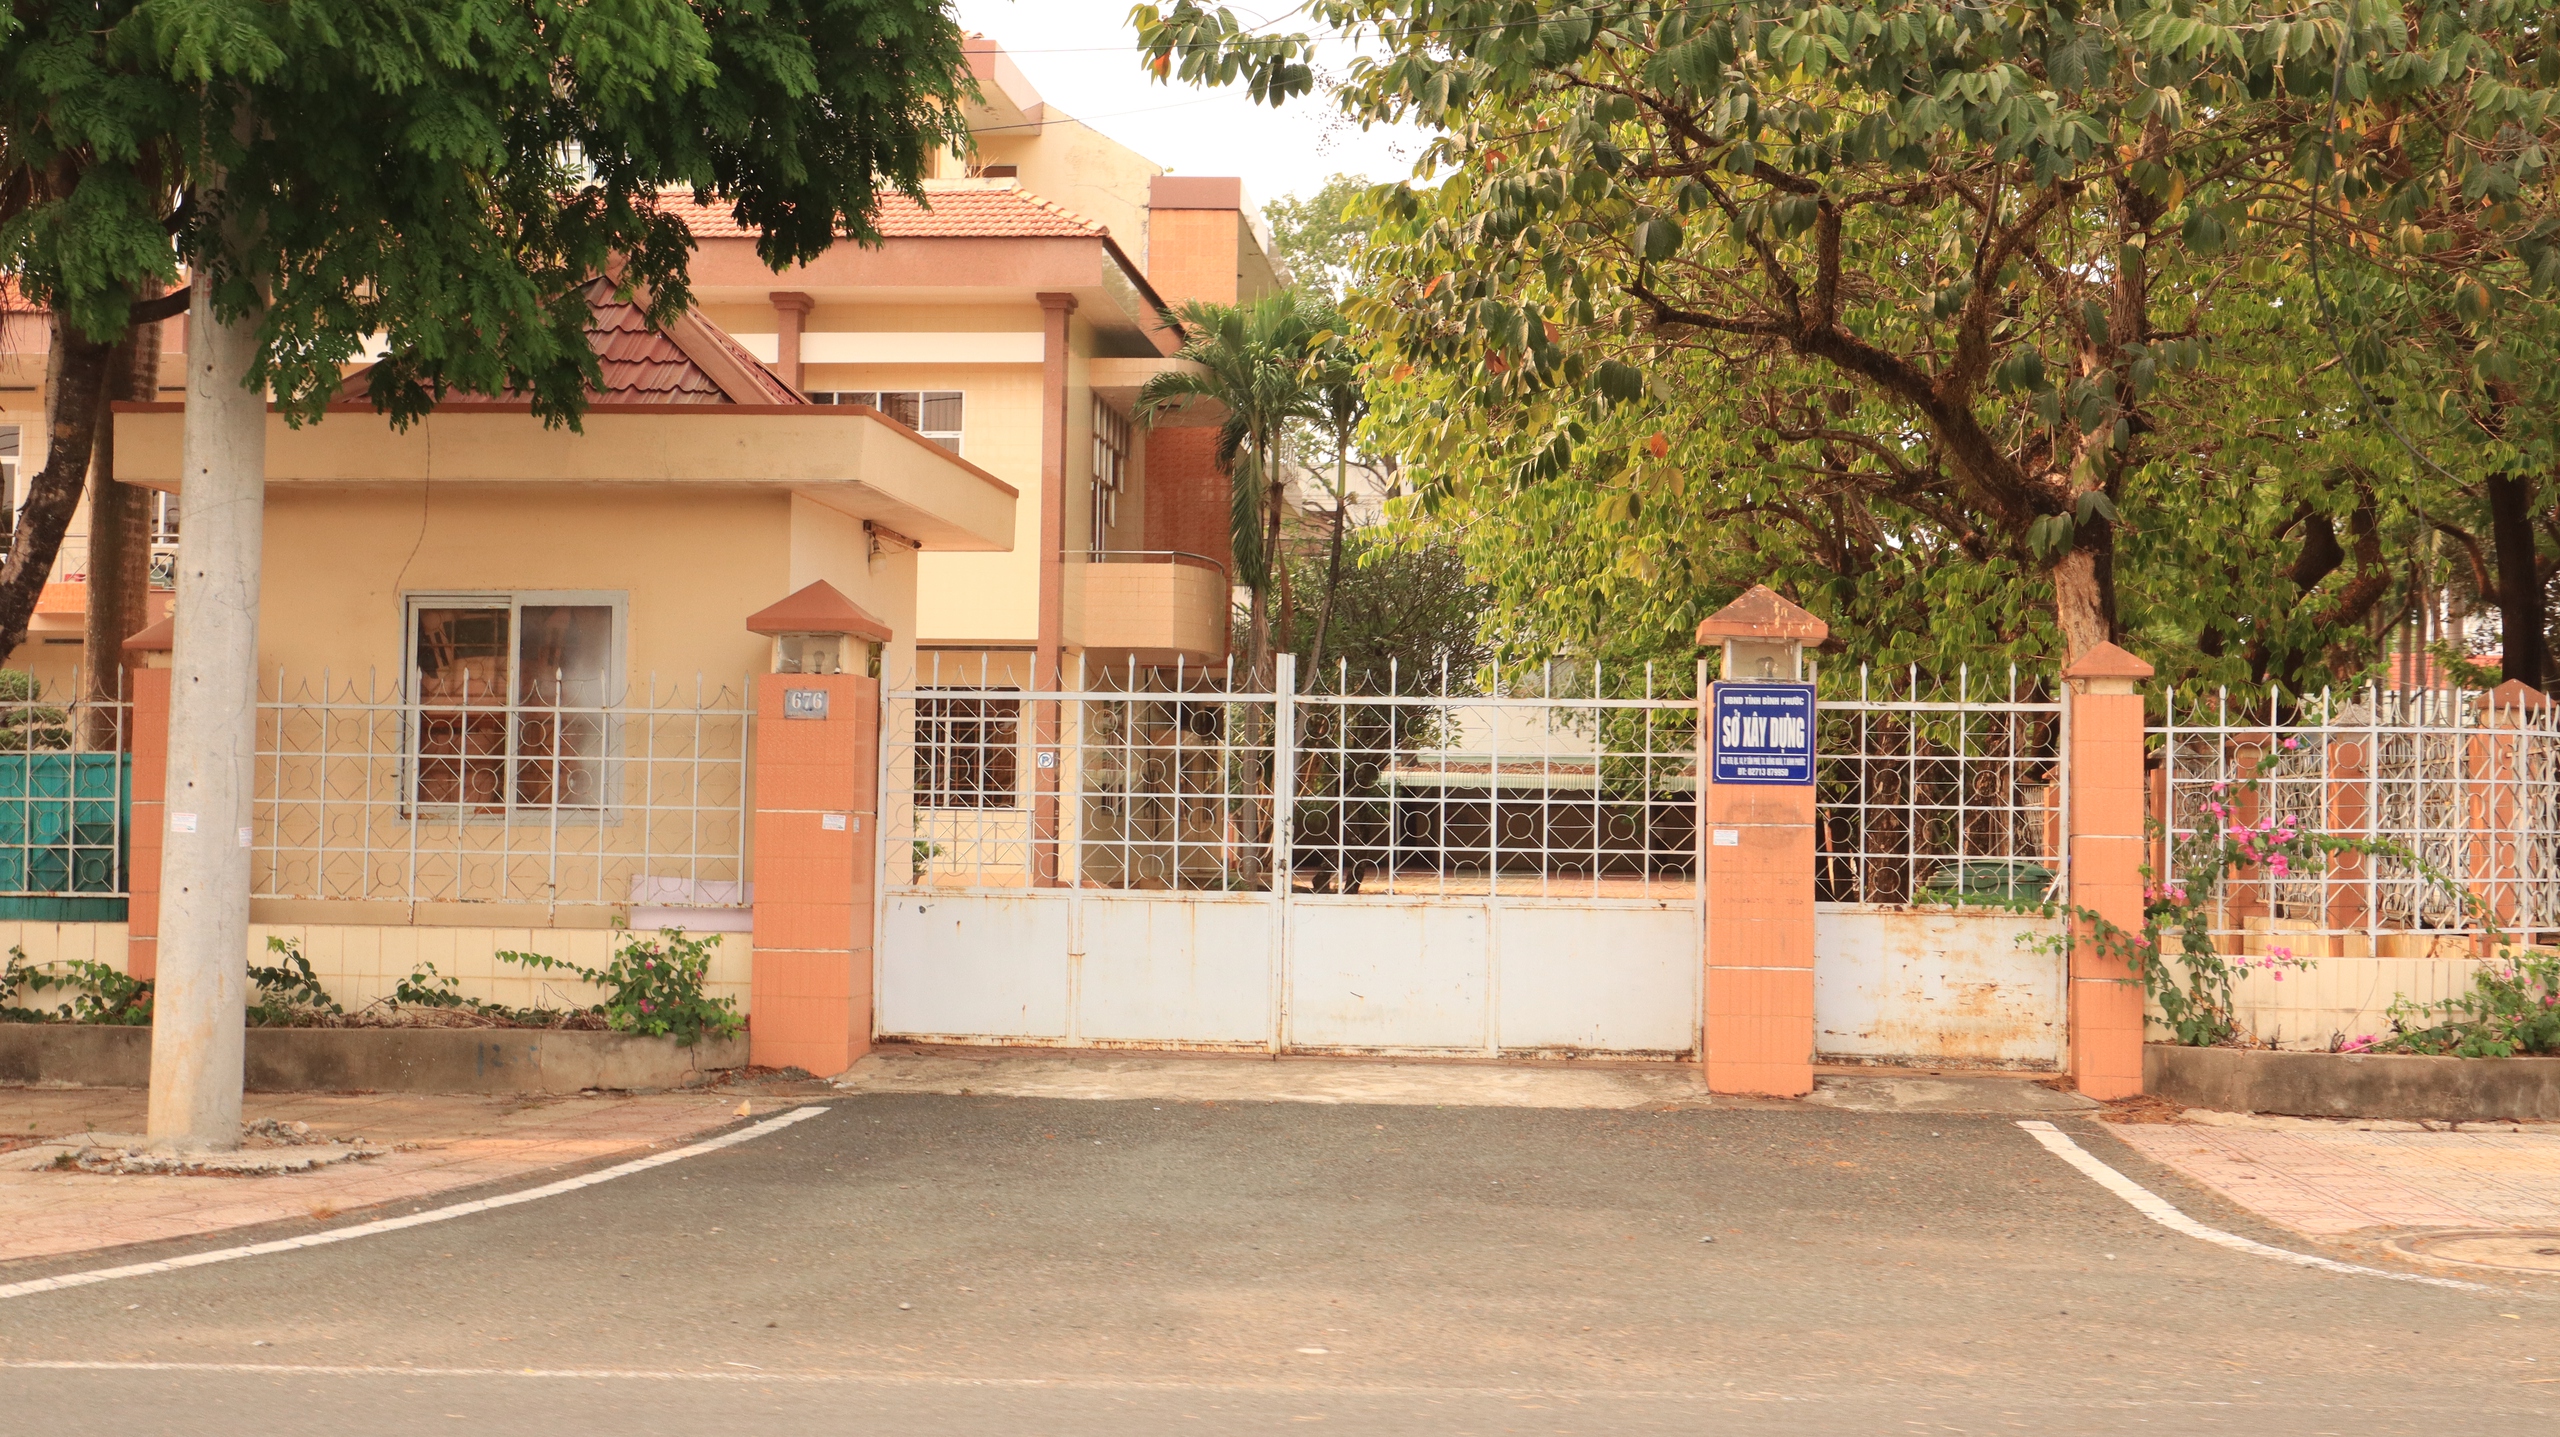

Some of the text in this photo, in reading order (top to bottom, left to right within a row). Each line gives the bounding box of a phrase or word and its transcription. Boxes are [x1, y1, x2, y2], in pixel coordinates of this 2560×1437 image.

[792, 691, 822, 709] 676
[1724, 696, 1743, 705] UBND
[1762, 695, 1780, 705] BÌNH
[1780, 695, 1804, 706] PHƯỚC
[1722, 708, 1805, 754] SỞ XÂY DỰNG
[1747, 767, 1766, 776] 02713
